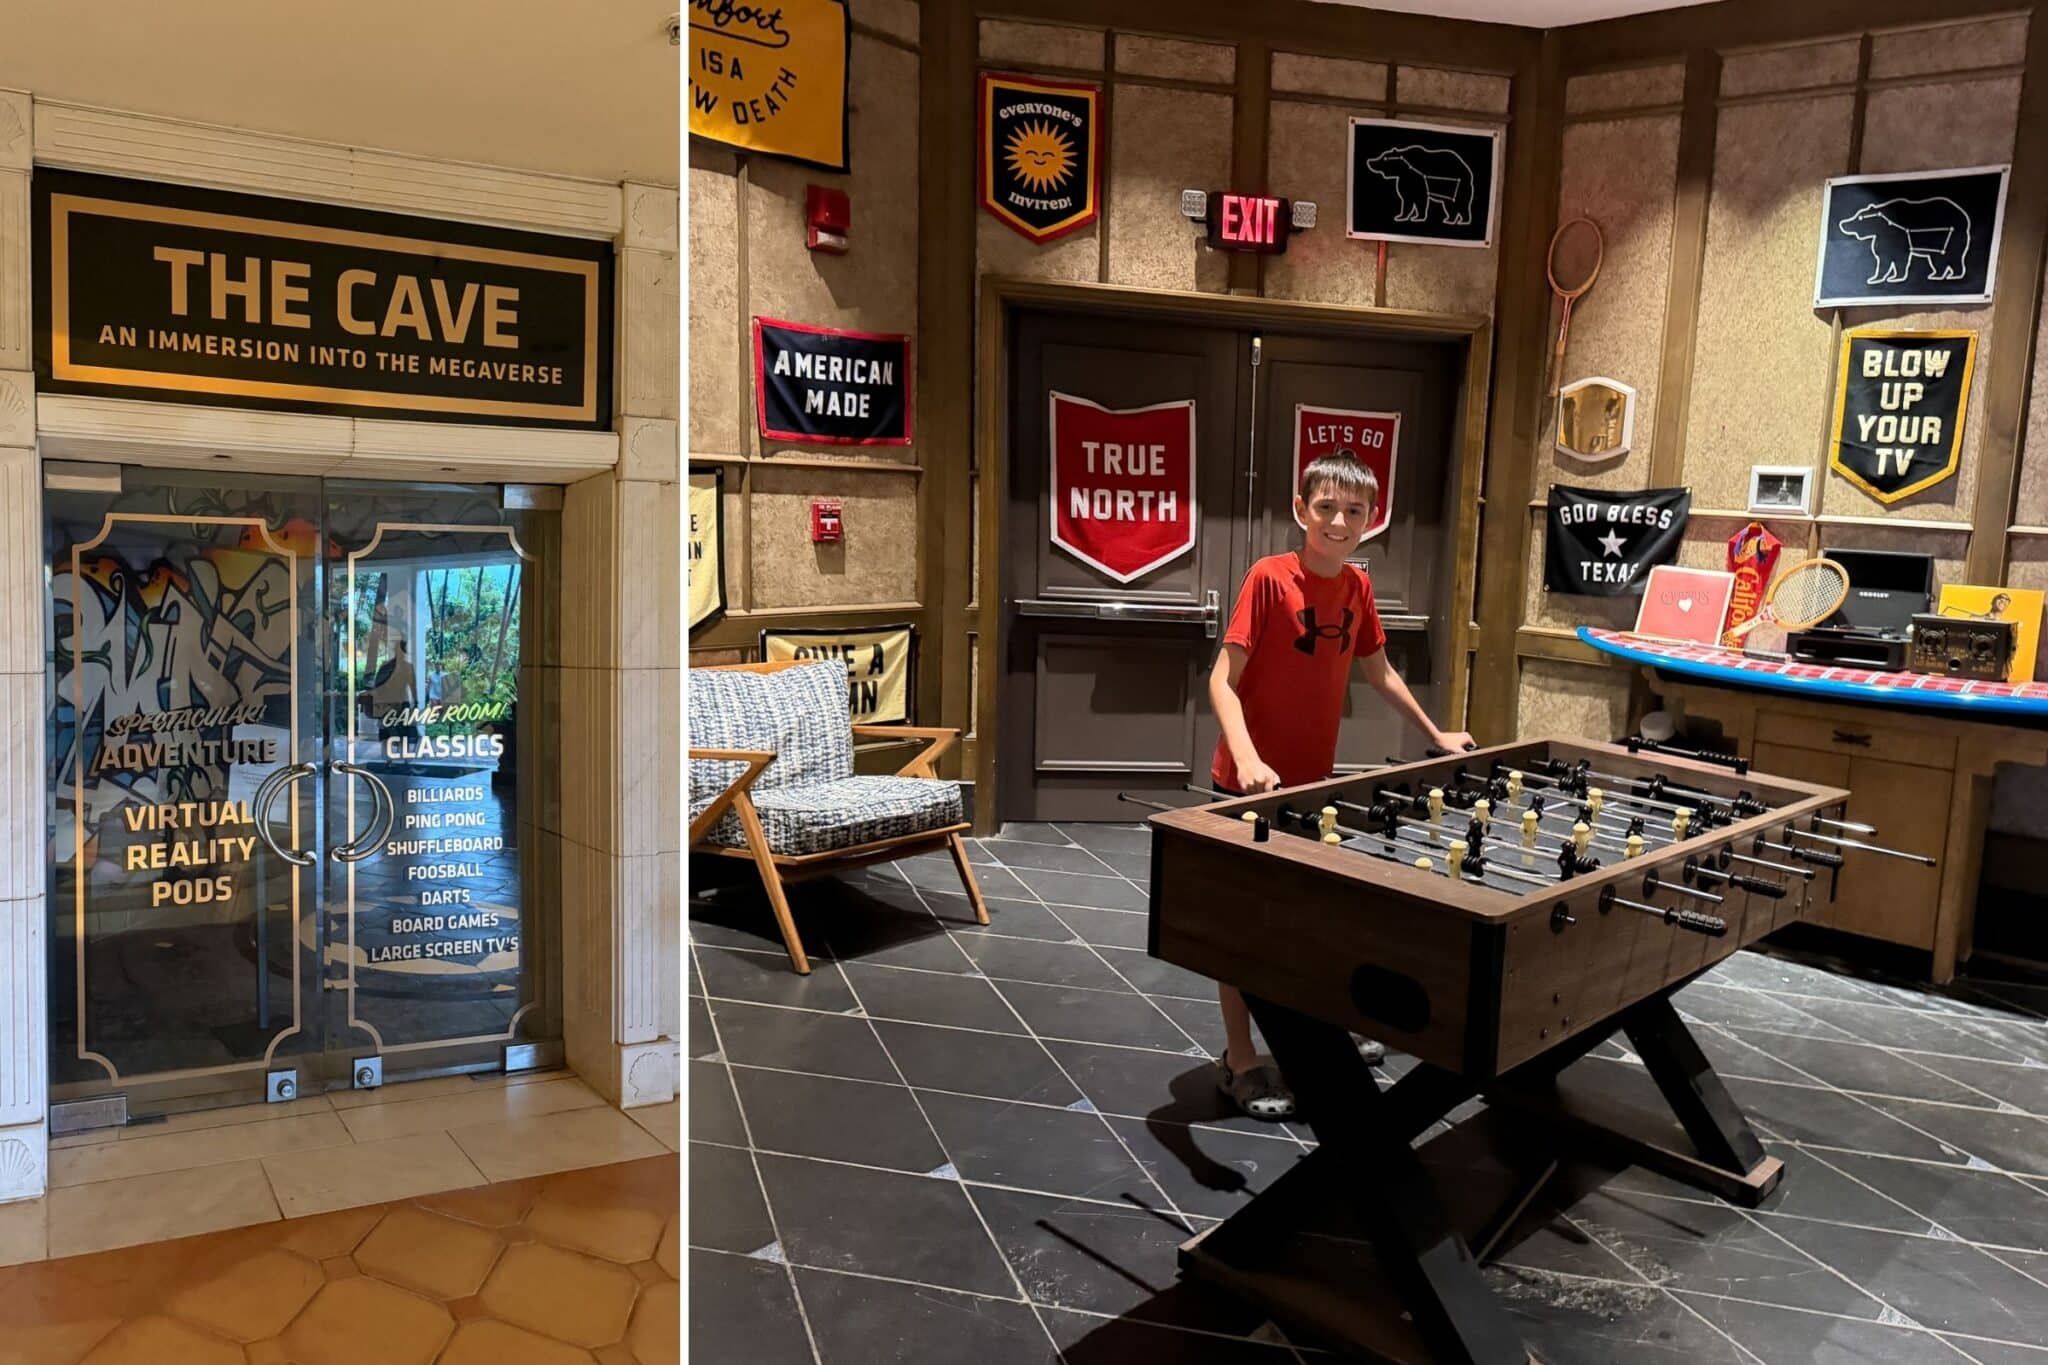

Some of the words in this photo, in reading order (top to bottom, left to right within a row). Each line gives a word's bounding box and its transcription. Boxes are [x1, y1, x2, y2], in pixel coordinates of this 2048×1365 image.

[701, 48, 723, 75] IS
[730, 57, 743, 80] A
[732, 67, 797, 124] DEATH
[1222, 195, 1279, 244] EXIT
[153, 246, 311, 329] THE
[337, 267, 520, 349] CAVE
[99, 325, 137, 347] AN
[148, 329, 299, 362] IMMERSION
[310, 345, 367, 369] INTO
[376, 352, 420, 373] THE
[429, 356, 563, 385] MEGAVERSE
[774, 350, 893, 385] AMERICAN
[1863, 349, 1951, 378] BLOW
[805, 389, 870, 418] MADE
[1880, 382, 1923, 411] UP
[1308, 425, 1354, 445] LET'S
[1361, 428, 1384, 448] GO
[1857, 414, 1942, 445] YOUR
[1082, 441, 1165, 476] TRUE
[1875, 448, 1915, 476] TV
[1070, 486, 1177, 522] NORTH
[1560, 503, 1598, 526] GOD
[1607, 505, 1673, 530] BLESS
[868, 643, 884, 675] A
[108, 703, 267, 737] SPECTACULAR!
[383, 704, 440, 727] GAME
[442, 702, 508, 724] ROOM!
[100, 738, 279, 769] ADVENTURE
[386, 734, 504, 759] CLASSICS
[407, 786, 483, 803] BILLIARDS
[125, 801, 256, 831] VIRTUAL
[405, 813, 441, 829] PING
[445, 812, 485, 827] PONG
[127, 837, 256, 870] REALITY
[387, 836, 503, 856] SHUFFLEBOARD
[408, 862, 483, 880] FOOSBALL
[152, 876, 232, 907] PODS
[422, 889, 470, 905] DARTS
[392, 916, 444, 933] BOARD
[448, 912, 499, 930] GAMES
[371, 944, 420, 962] LARGE
[425, 940, 482, 959] SCREEN
[486, 935, 519, 954] TV'S
